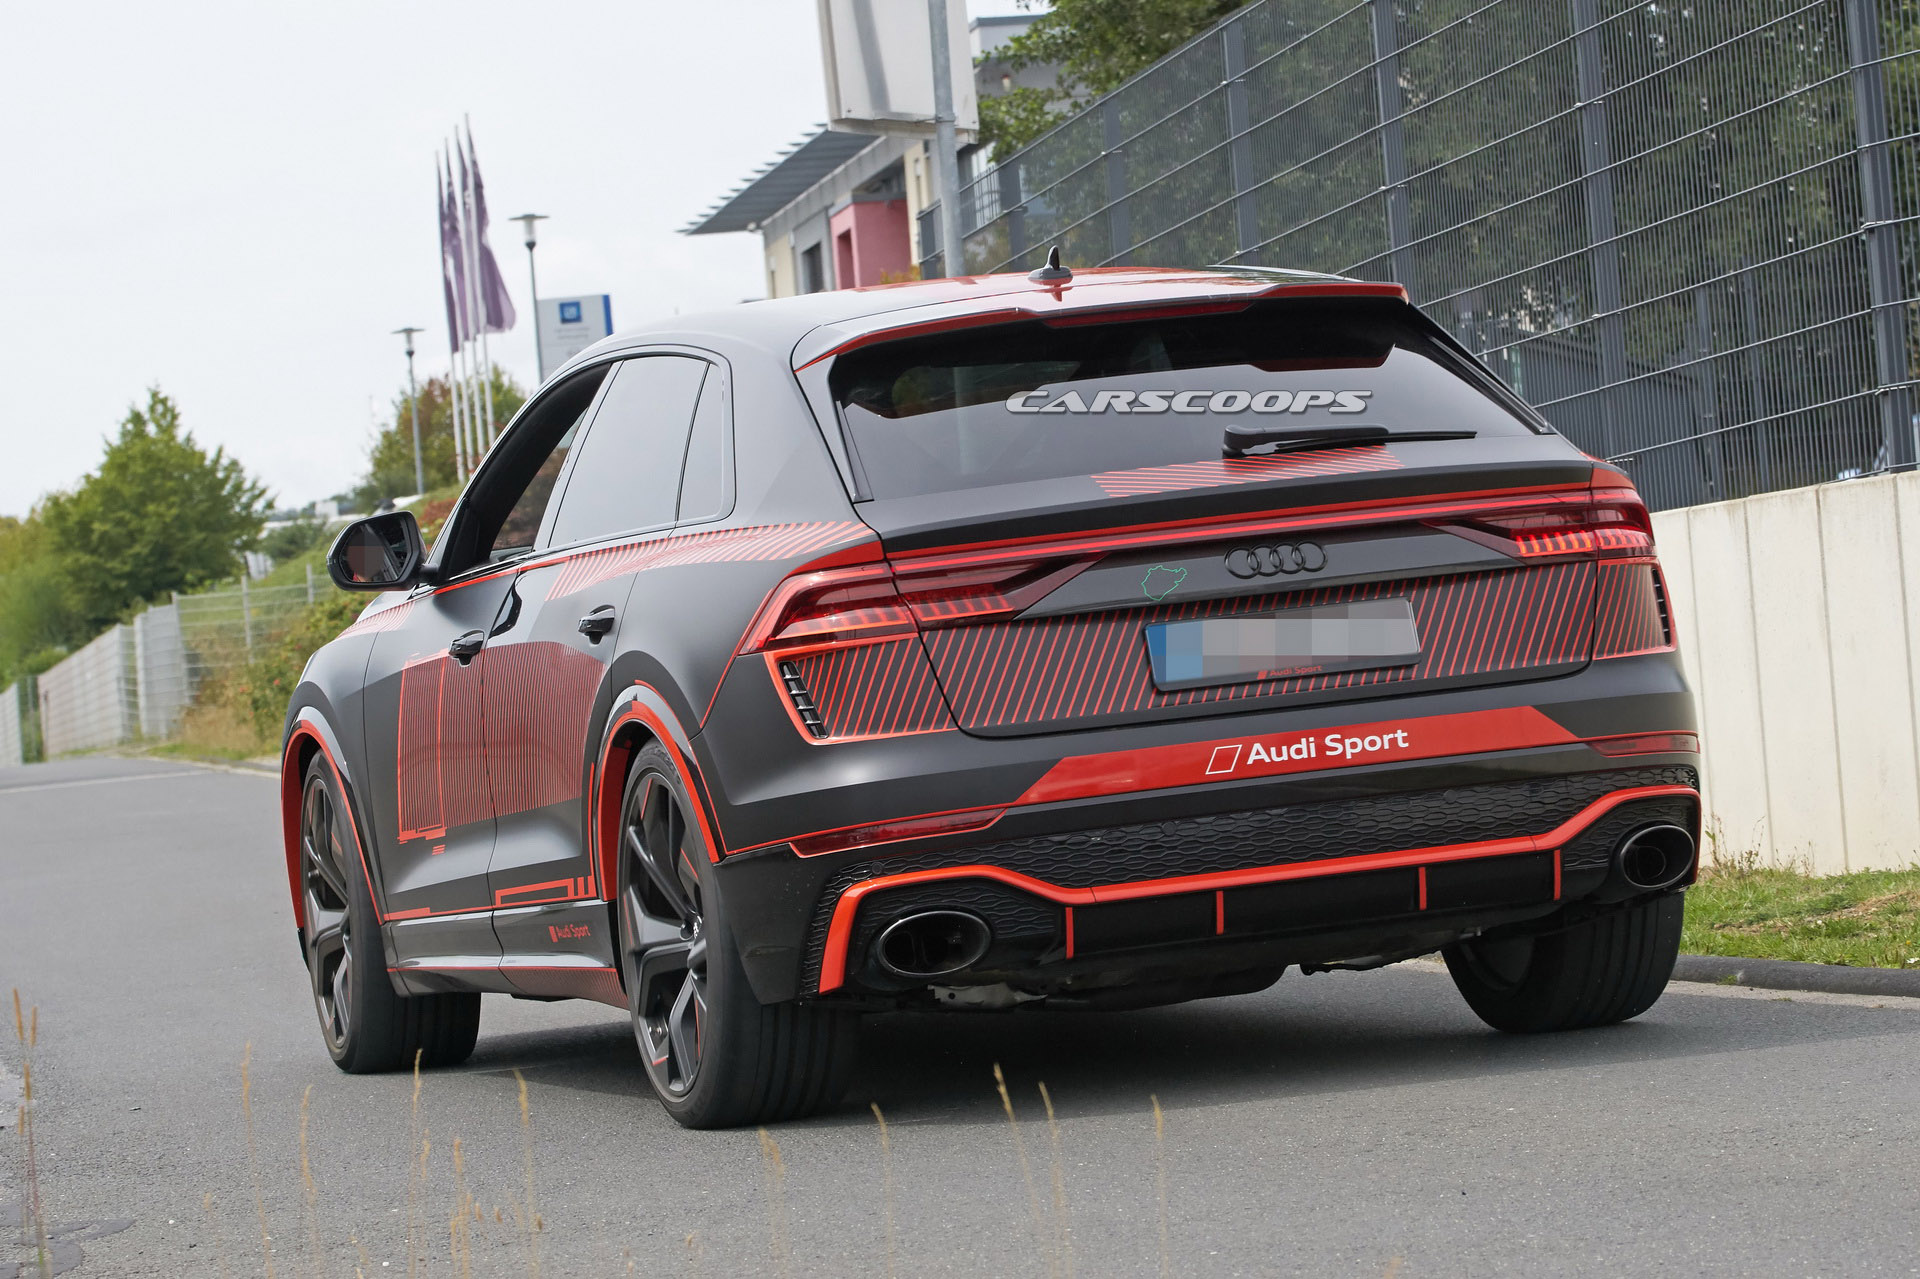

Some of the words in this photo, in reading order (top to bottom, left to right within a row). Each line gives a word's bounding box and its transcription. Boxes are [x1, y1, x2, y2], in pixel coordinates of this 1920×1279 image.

[1269, 667, 1292, 677] Audi
[1294, 665, 1323, 675] Sport
[1246, 736, 1317, 766] Audi
[1324, 728, 1410, 760] Sport
[556, 924, 573, 938] Audi
